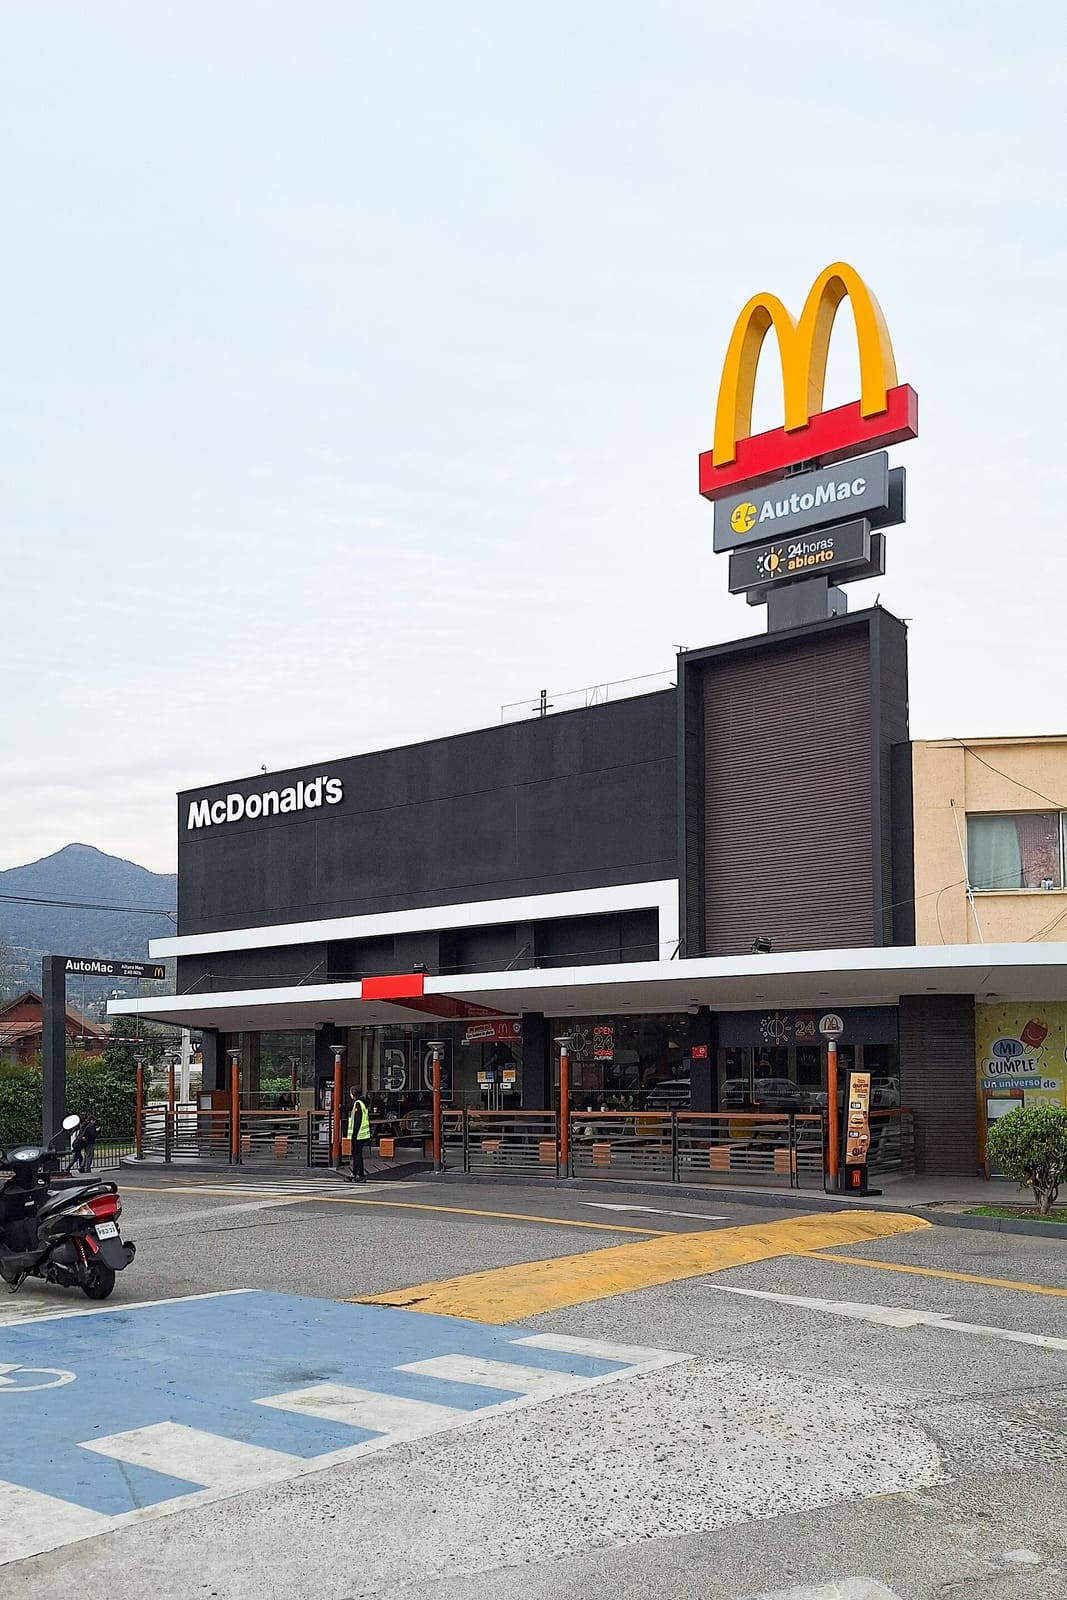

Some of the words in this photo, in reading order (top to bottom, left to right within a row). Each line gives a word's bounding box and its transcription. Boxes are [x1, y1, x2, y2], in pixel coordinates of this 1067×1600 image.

[759, 477, 866, 523] AutoMac
[788, 550, 834, 570] abierto
[187, 776, 344, 830] McDonald's
[65, 960, 113, 973] AutoMac
[594, 1027, 614, 1035] OPEN
[795, 1020, 816, 1036] 24
[594, 1034, 615, 1051] 24
[1000, 1042, 1016, 1055] MI
[989, 1059, 1036, 1074] CUMPLE
[984, 1081, 997, 1089] Un
[999, 1078, 1040, 1088] universo
[1043, 1080, 1057, 1089] de
